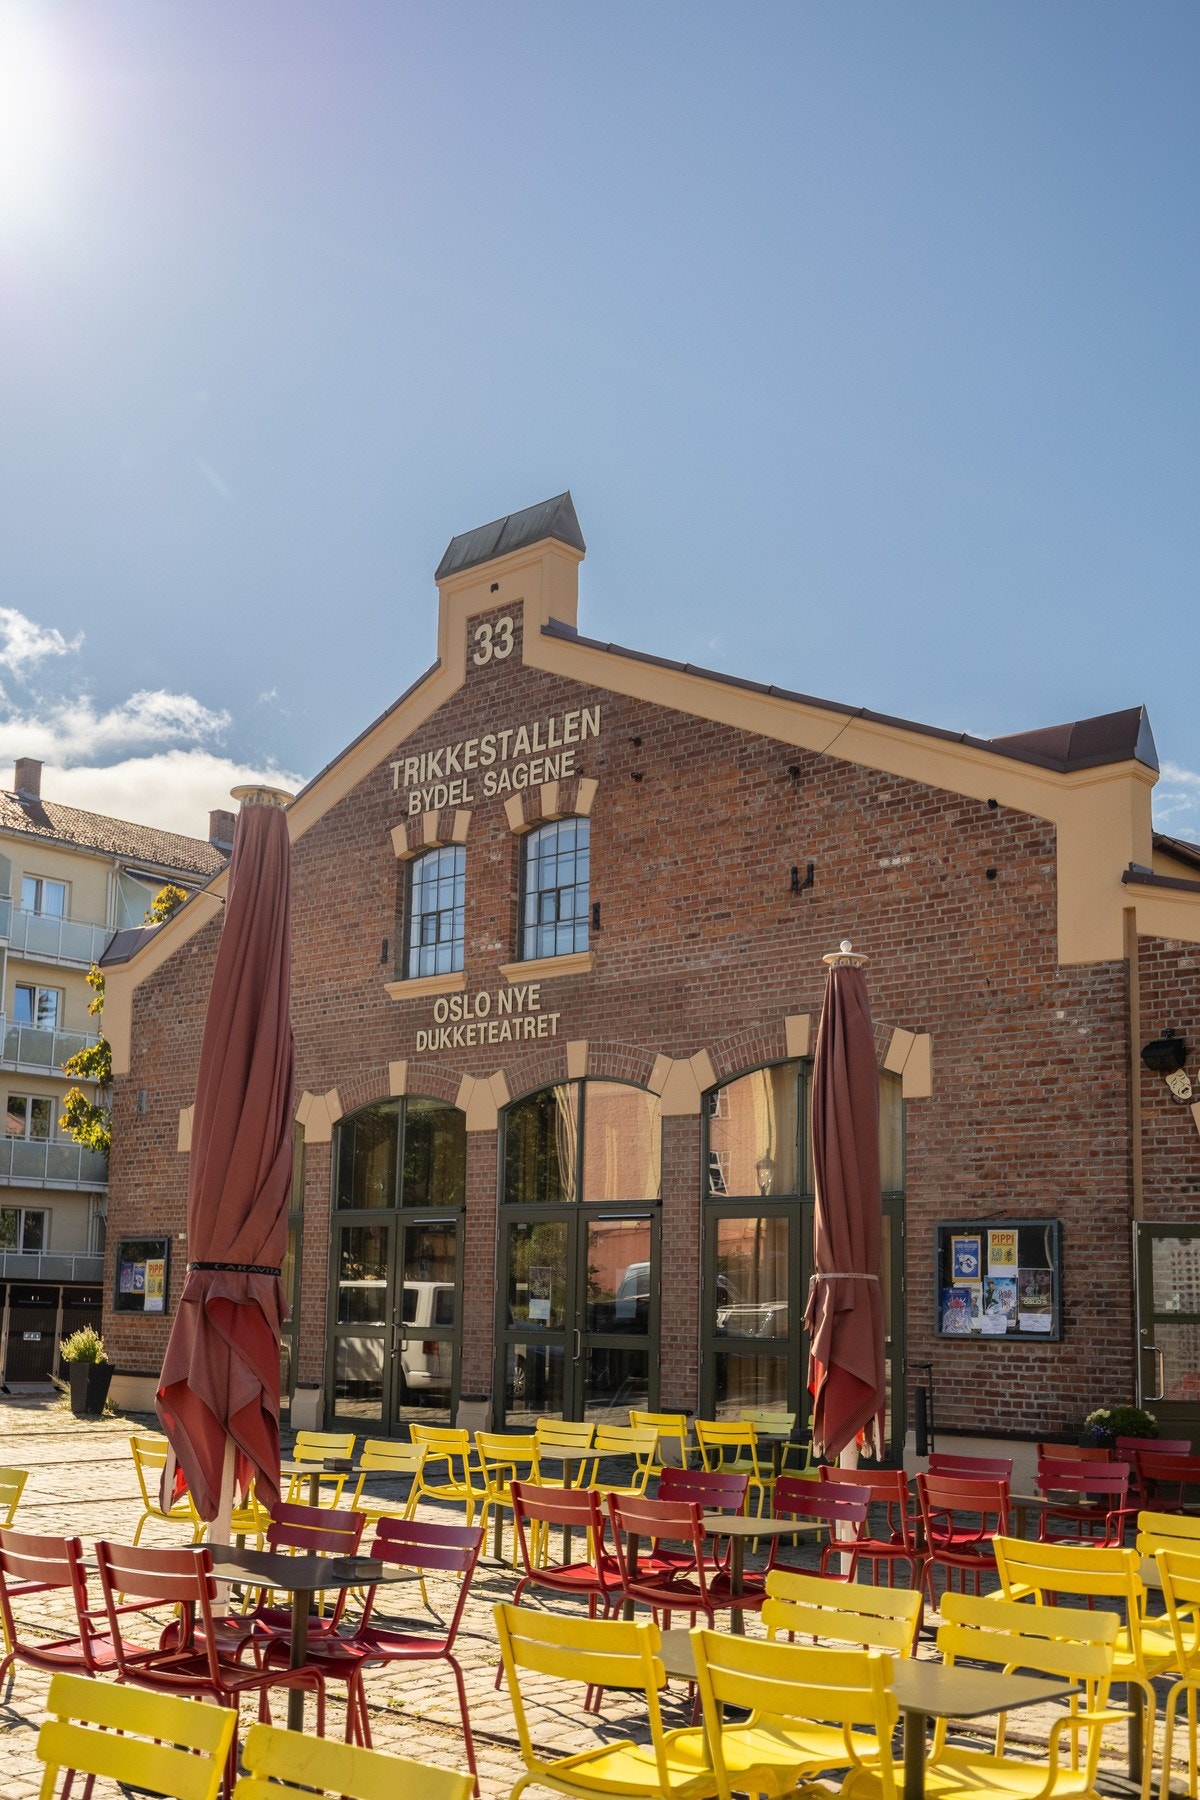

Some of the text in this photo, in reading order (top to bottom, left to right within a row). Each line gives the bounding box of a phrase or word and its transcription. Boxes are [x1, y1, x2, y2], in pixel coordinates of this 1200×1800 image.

[473, 616, 514, 666] 33
[390, 705, 601, 790] TRIKKESTALLEN
[408, 750, 576, 816] BYDEL SAGENE
[433, 984, 541, 1024] OSLO NYE
[416, 1013, 561, 1052] DUKKETEATRET
[992, 1234, 1014, 1243] PIPPI
[149, 1265, 164, 1274] PIPP
[214, 1263, 281, 1275] CARAVITA
